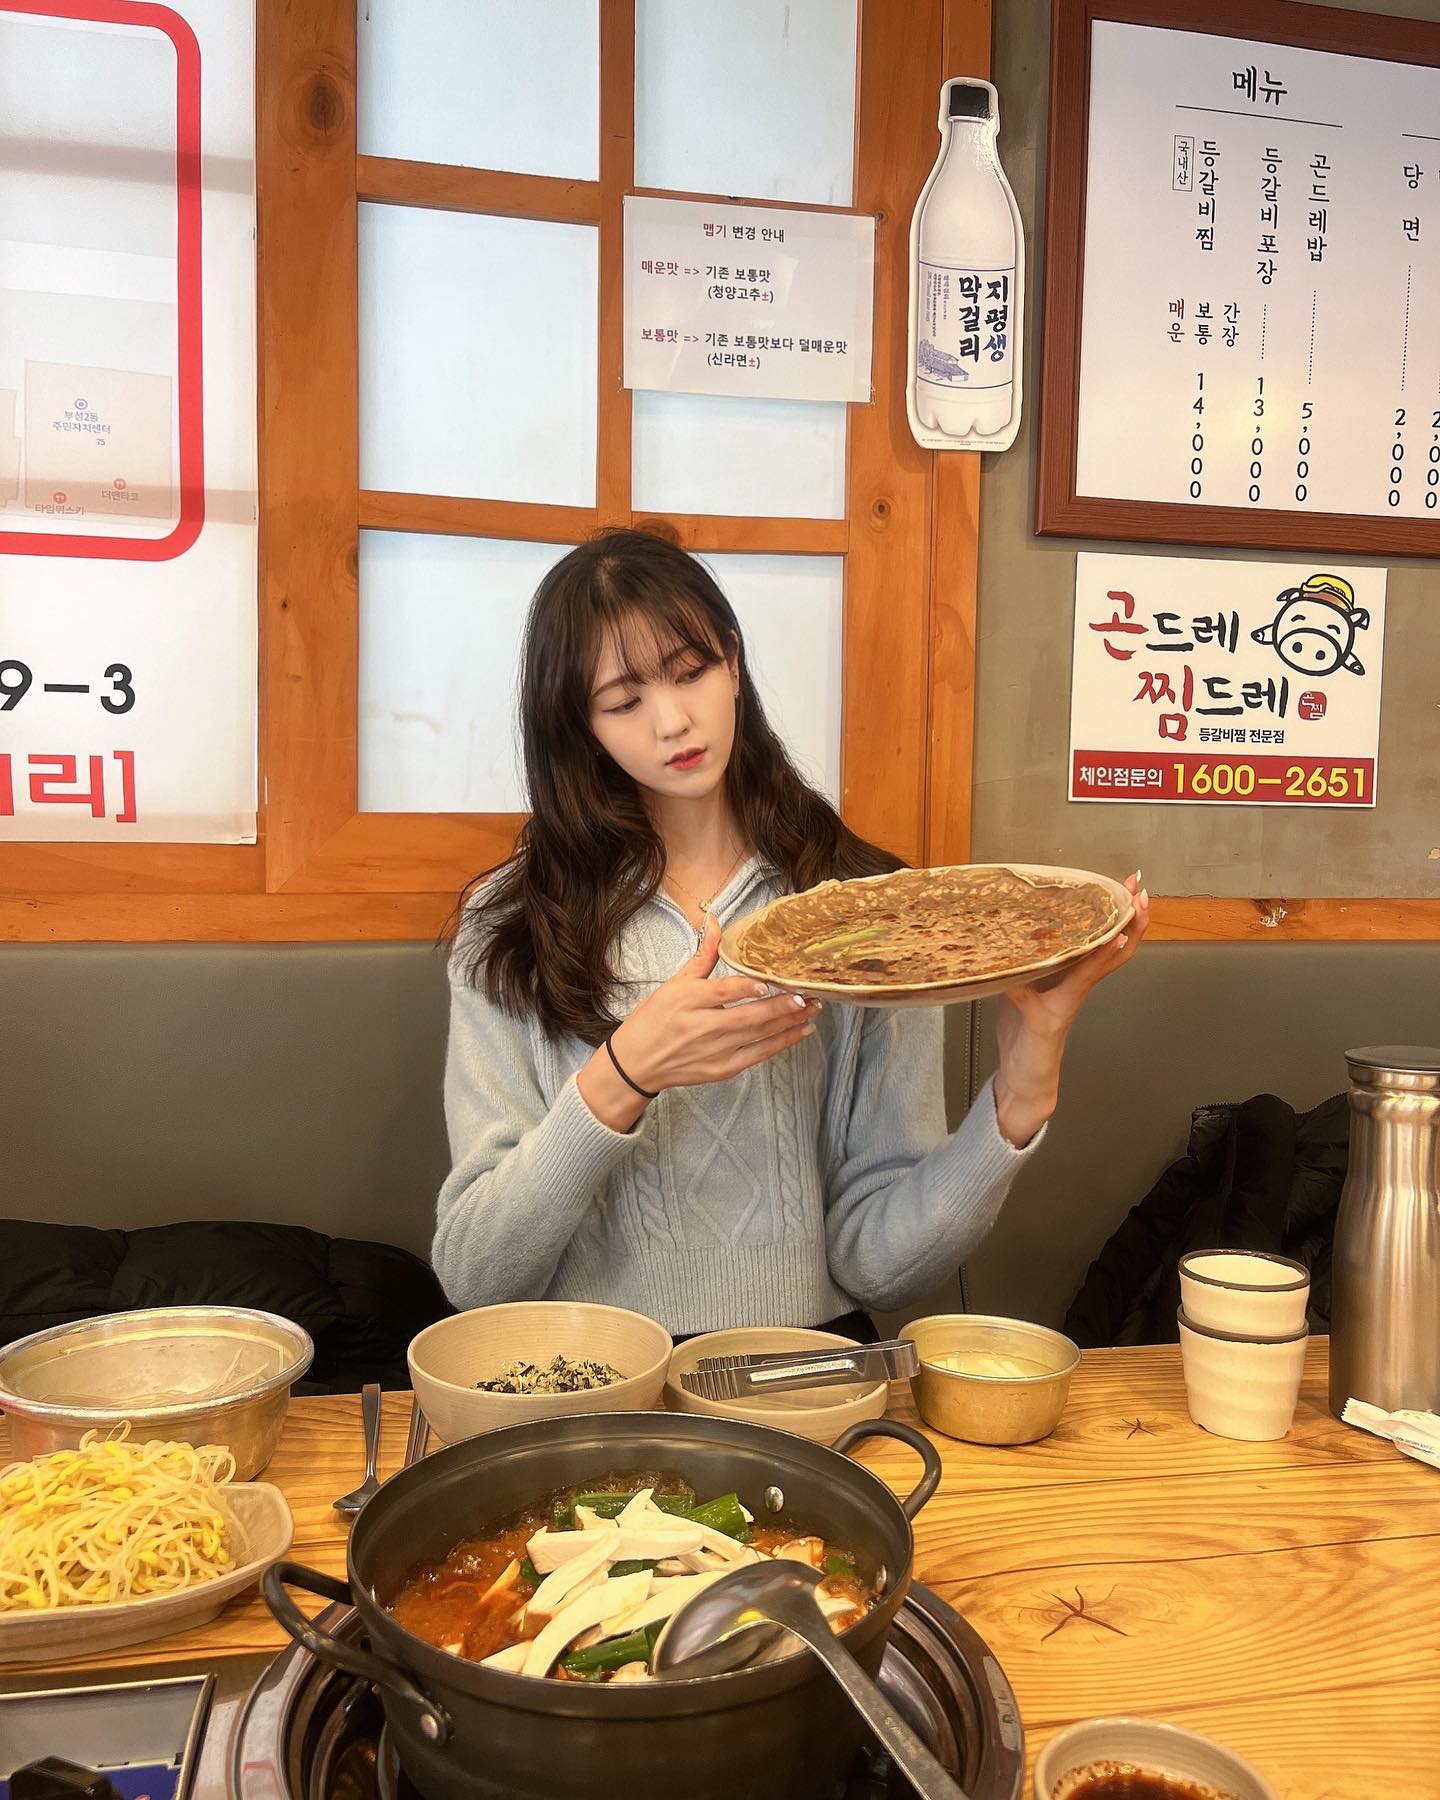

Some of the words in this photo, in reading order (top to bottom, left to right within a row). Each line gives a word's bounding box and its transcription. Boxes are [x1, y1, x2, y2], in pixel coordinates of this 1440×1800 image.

[1232, 66, 1289, 105] 메뉴
[1177, 141, 1190, 186] 국내산
[1196, 141, 1221, 251] 등갈비찜
[703, 224, 727, 238] 맵기
[733, 226, 756, 240] 변경
[762, 229, 785, 242] 안내
[1257, 148, 1283, 285] 등갈비포장
[1306, 154, 1331, 262] 곤드레밥
[641, 261, 678, 275] 매운맛
[706, 266, 729, 280] 기존
[735, 268, 770, 283] 보통맛
[641, 329, 678, 343] 보통맛
[705, 333, 728, 347] 기존
[735, 335, 794, 351] 보통맛보다
[799, 340, 847, 354] 덜매운맛
[959, 275, 982, 362] 막걸리
[983, 276, 1008, 362] 지평생
[1167, 299, 1186, 342] 매운
[1194, 302, 1213, 345] 보통
[1221, 303, 1241, 348] 간장
[1190, 372, 1205, 499] 14,000
[1248, 377, 1265, 503] 13,000
[1295, 403, 1313, 502] 5,000
[1388, 408, 1406, 507] 2,000
[1089, 591, 1240, 660] 곤드레
[1133, 665, 1289, 741] 찜드레
[1199, 728, 1246, 743] 등갈비찜
[1249, 730, 1285, 744] 전문점
[0, 750, 137, 823] 리]
[1080, 765, 1163, 787] 체인점문의
[1173, 763, 1365, 797] 1600-2651
